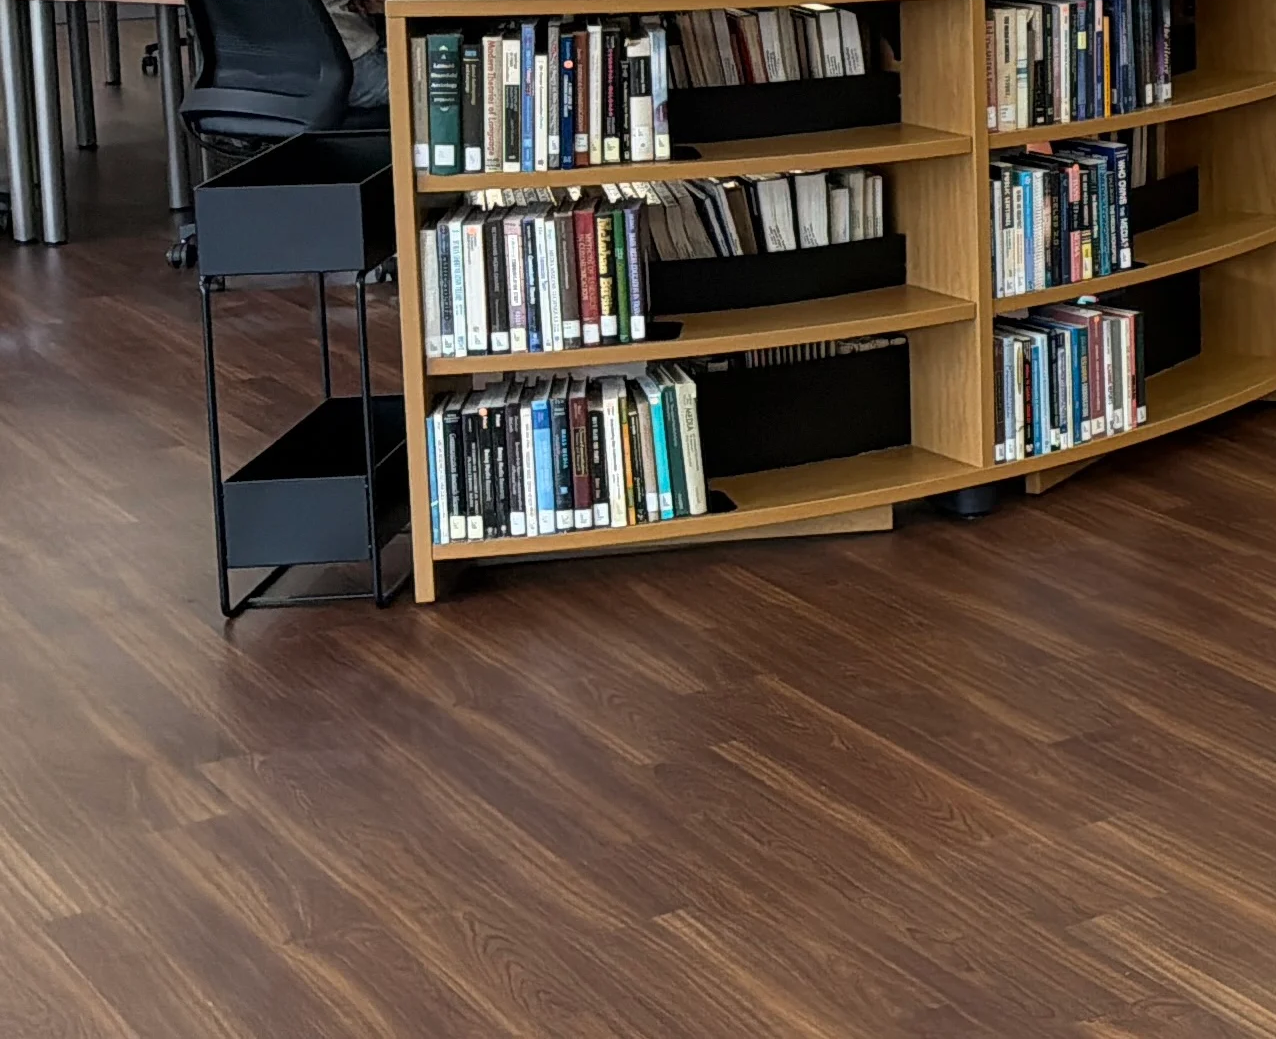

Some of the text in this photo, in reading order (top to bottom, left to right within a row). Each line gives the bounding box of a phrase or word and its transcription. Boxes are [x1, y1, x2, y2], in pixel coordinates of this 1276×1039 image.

[486, 41, 497, 157] Modern Theories of Language
[1118, 159, 1127, 179] WHO
[1118, 180, 1128, 205] OWNS
[1120, 217, 1129, 247] MEDIA?
